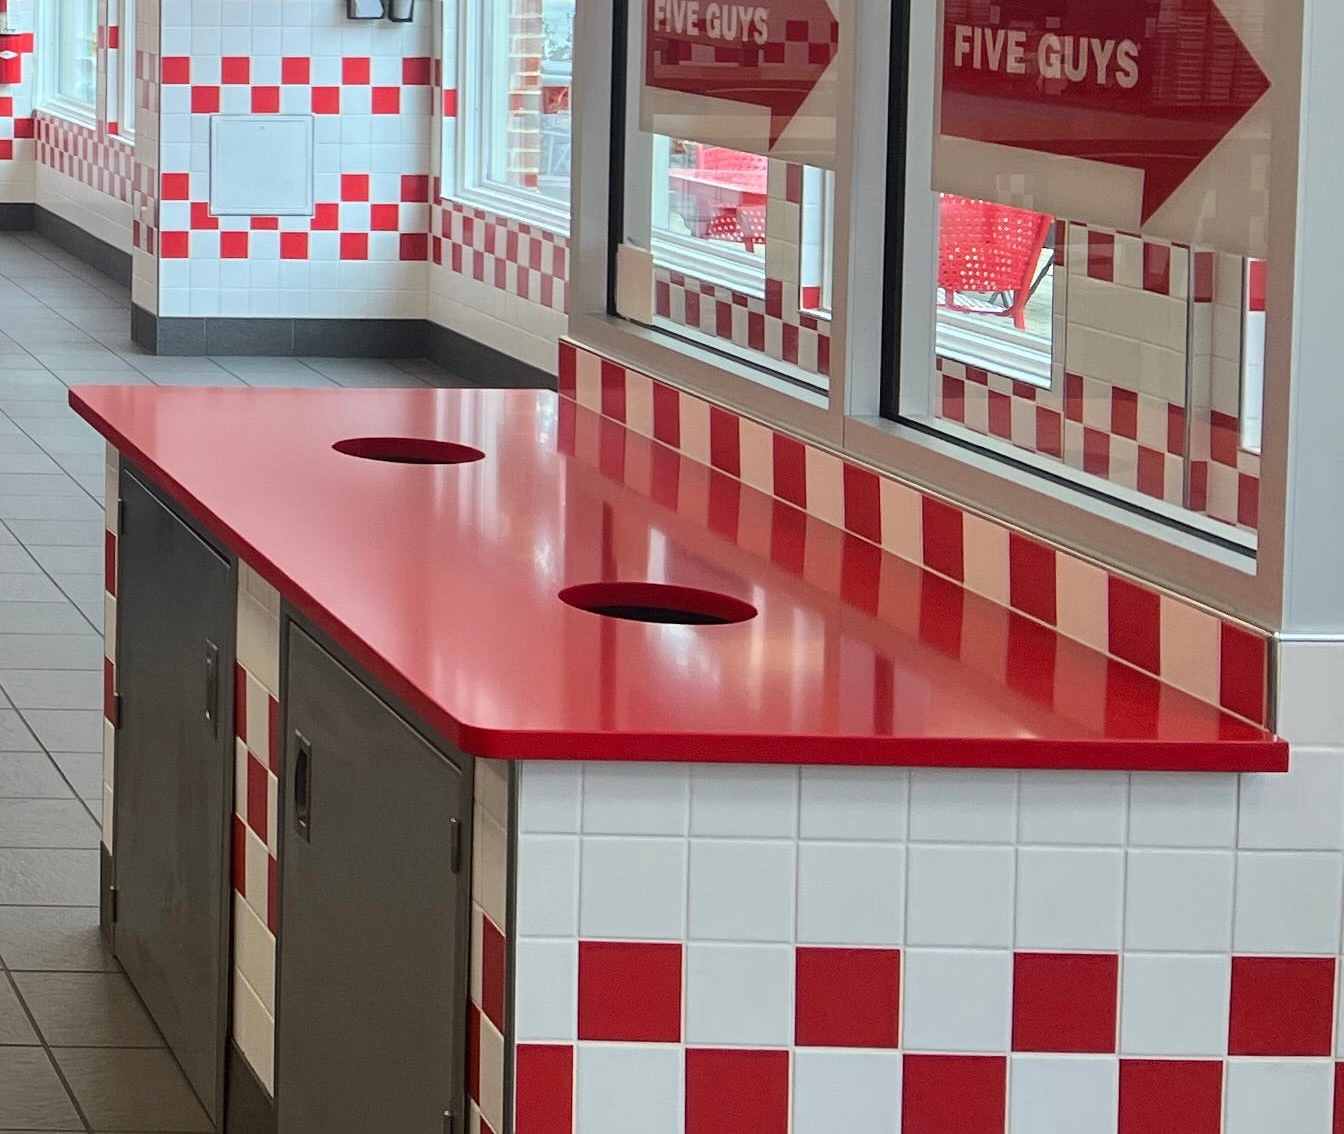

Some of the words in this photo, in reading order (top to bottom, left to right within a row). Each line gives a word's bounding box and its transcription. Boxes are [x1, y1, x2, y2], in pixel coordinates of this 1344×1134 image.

[705, 2, 769, 45] GUYS
[954, 24, 1026, 74] FIVE
[1037, 32, 1140, 89] GUYS
